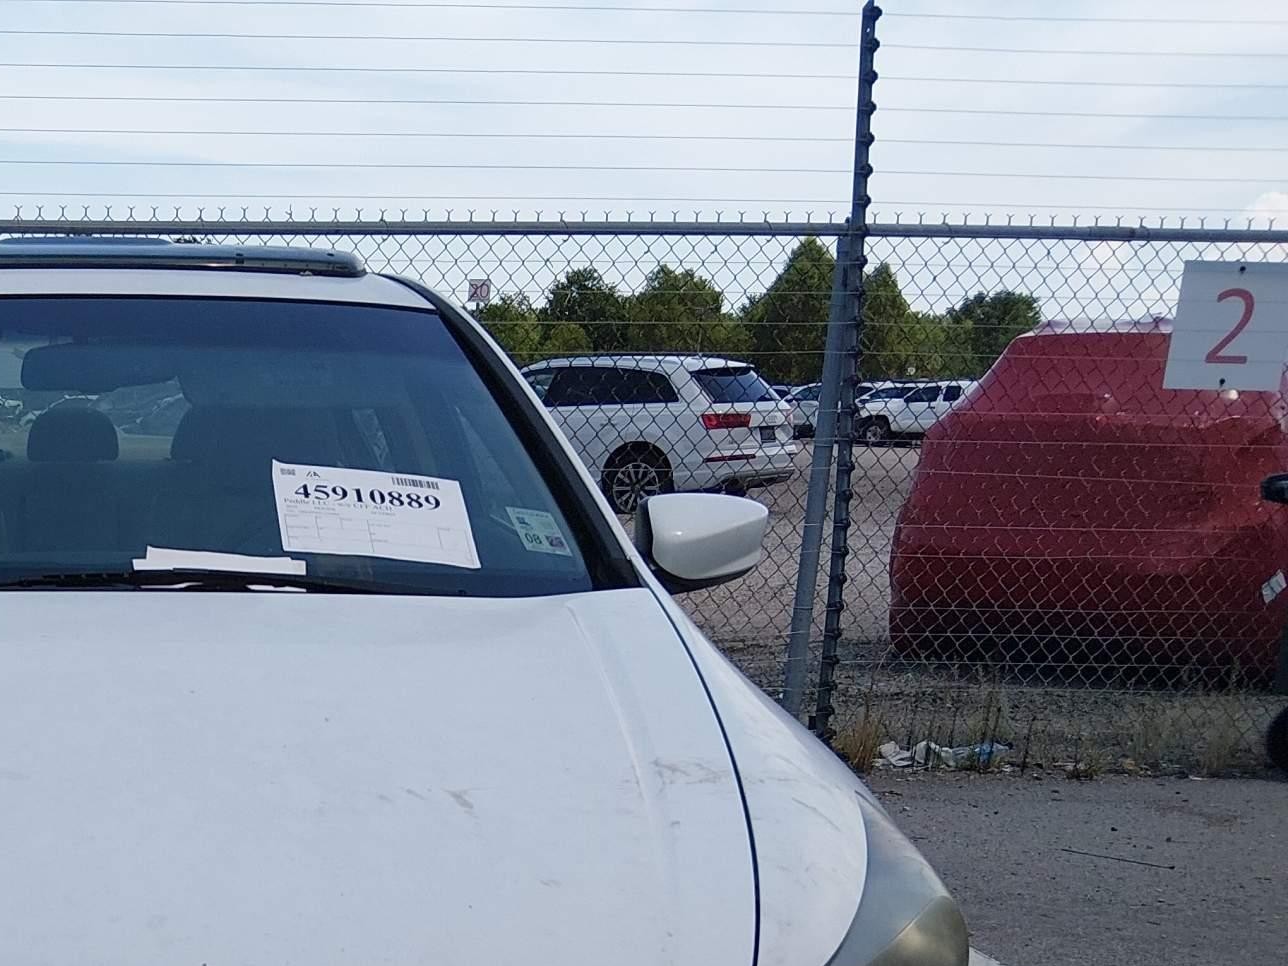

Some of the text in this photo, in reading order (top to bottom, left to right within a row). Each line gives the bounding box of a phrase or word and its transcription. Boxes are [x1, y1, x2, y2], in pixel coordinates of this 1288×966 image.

[470, 283, 490, 299] 20
[1204, 287, 1255, 364] 2
[294, 483, 441, 511] 45910889
[524, 532, 542, 545] 08
